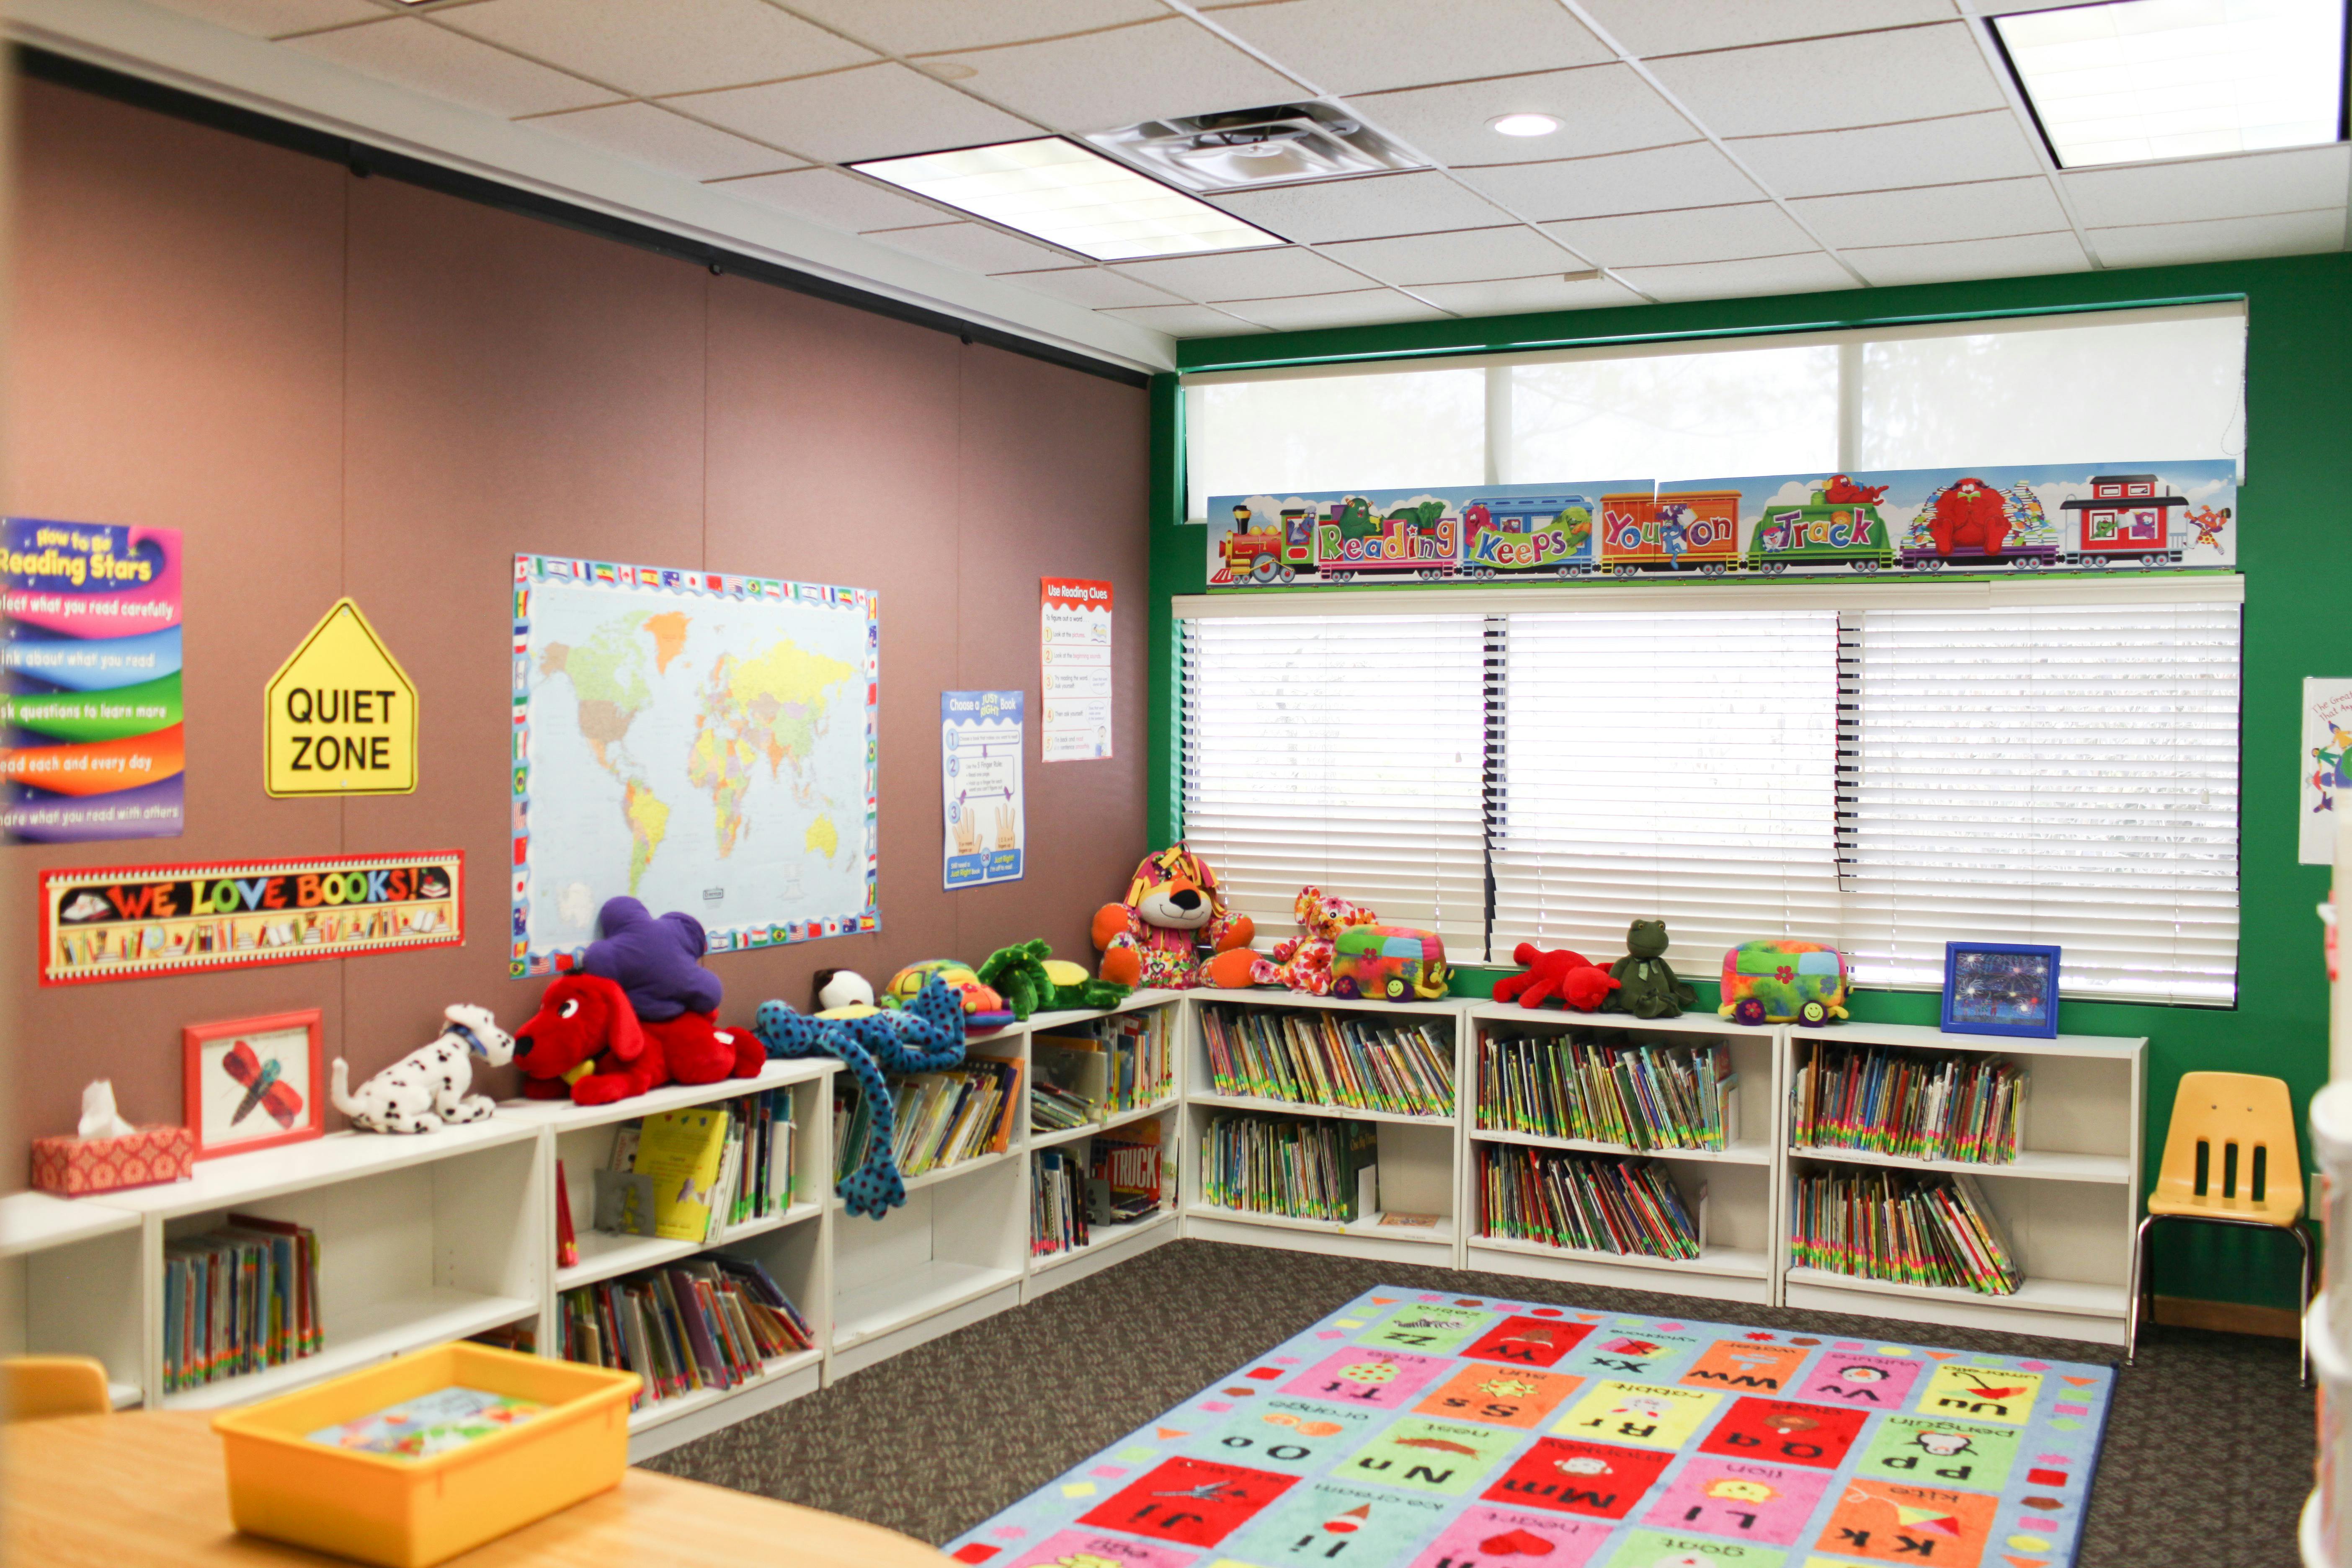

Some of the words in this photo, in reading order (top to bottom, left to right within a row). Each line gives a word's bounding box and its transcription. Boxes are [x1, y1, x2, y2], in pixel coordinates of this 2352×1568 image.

[37, 528, 69, 547] How
[72, 531, 88, 551] to
[91, 535, 111, 552] Be
[1320, 518, 1456, 560] Reading
[1475, 529, 1567, 565] Keeps
[1604, 509, 1661, 548] You
[1690, 513, 1733, 547] on
[1774, 506, 1871, 550] Track
[0, 547, 86, 585] Reading
[90, 554, 152, 582] Stars
[1048, 585, 1060, 596] Use
[1062, 585, 1088, 601] Reading
[1089, 587, 1107, 599] Clues
[31, 596, 60, 612] what
[64, 600, 86, 618] you
[89, 598, 119, 616] read
[121, 601, 173, 621] carefully
[26, 650, 63, 668] about
[67, 652, 98, 667] what
[101, 655, 122, 670] you
[126, 652, 155, 668] read
[1046, 650, 1050, 660] 2
[1047, 677, 1050, 686] 3
[287, 688, 396, 724] QUIET
[950, 699, 973, 711] Choose
[982, 694, 998, 705] JUST
[1001, 699, 1016, 710] Book
[2312, 702, 2328, 713] The
[20, 703, 81, 722] questions
[84, 703, 97, 719] to
[101, 703, 133, 718] learn
[136, 706, 166, 718] more
[980, 705, 999, 717] RIGHT
[1047, 710, 1051, 720] 4
[2319, 707, 2338, 721] That
[950, 733, 954, 745] 1
[291, 736, 390, 771] ZONE
[29, 756, 59, 772] each
[63, 755, 88, 771] and
[91, 757, 126, 773] every
[129, 754, 152, 773] day
[950, 759, 955, 772] 2
[29, 808, 59, 824] what
[62, 812, 83, 827] you
[86, 807, 115, 822] read
[117, 806, 141, 820] with
[144, 804, 179, 819] others
[952, 806, 957, 819] 3
[107, 882, 175, 920] WE
[191, 876, 286, 915] LOVE
[296, 869, 418, 908] BOOKS!
[1112, 1147, 1156, 1189] TRUCK
[1367, 1350, 1428, 1364] tree
[1723, 1342, 1797, 1356] water
[1831, 1354, 1920, 1369] vulture
[1498, 1368, 1547, 1381] sun
[1942, 1365, 2039, 1381] umbrella
[1613, 1382, 1704, 1399] rabbit
[1266, 1399, 1369, 1422] orange
[1422, 1422, 1490, 1439] nest
[1889, 1417, 2016, 1439] penguin
[1726, 1464, 1783, 1480] lion
[1313, 1483, 1402, 1504] cream
[1890, 1488, 1960, 1504] kite
[1658, 1537, 1746, 1558] goat
